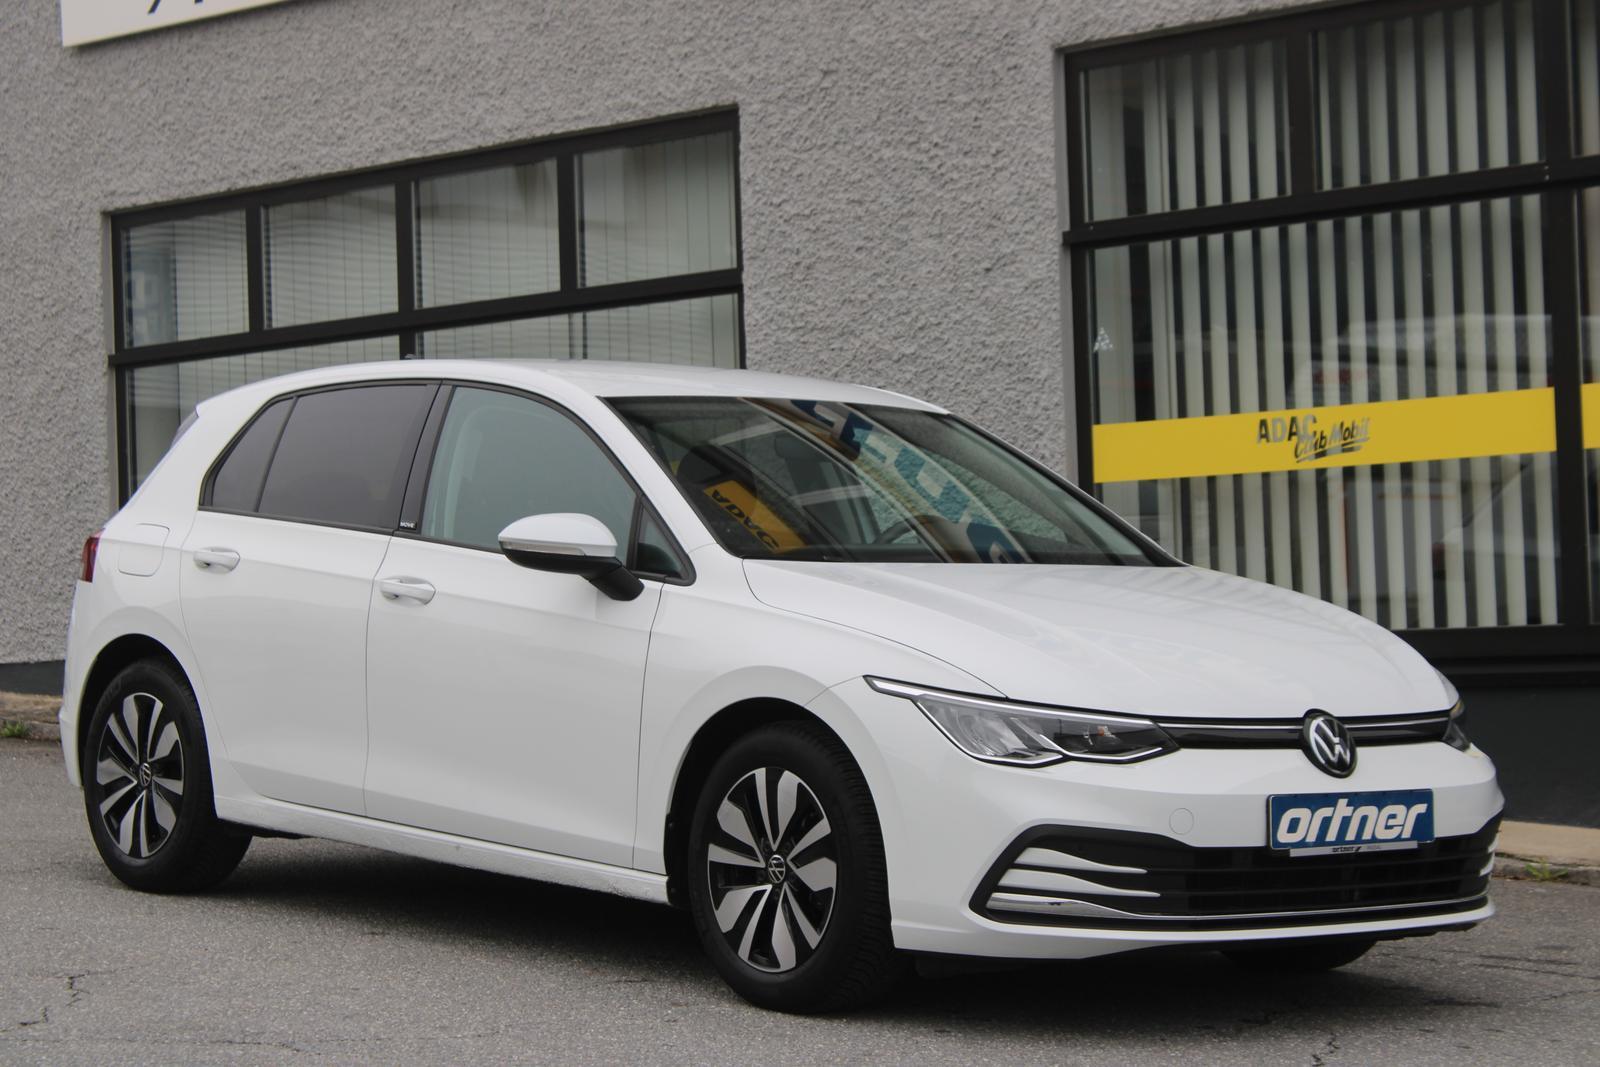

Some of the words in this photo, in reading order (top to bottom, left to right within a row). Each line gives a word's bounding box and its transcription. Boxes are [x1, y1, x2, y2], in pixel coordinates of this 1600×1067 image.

[1257, 414, 1318, 443] ADAC
[1294, 429, 1328, 459] Club
[1328, 417, 1371, 446] Mobil
[1276, 798, 1428, 844] ortner
